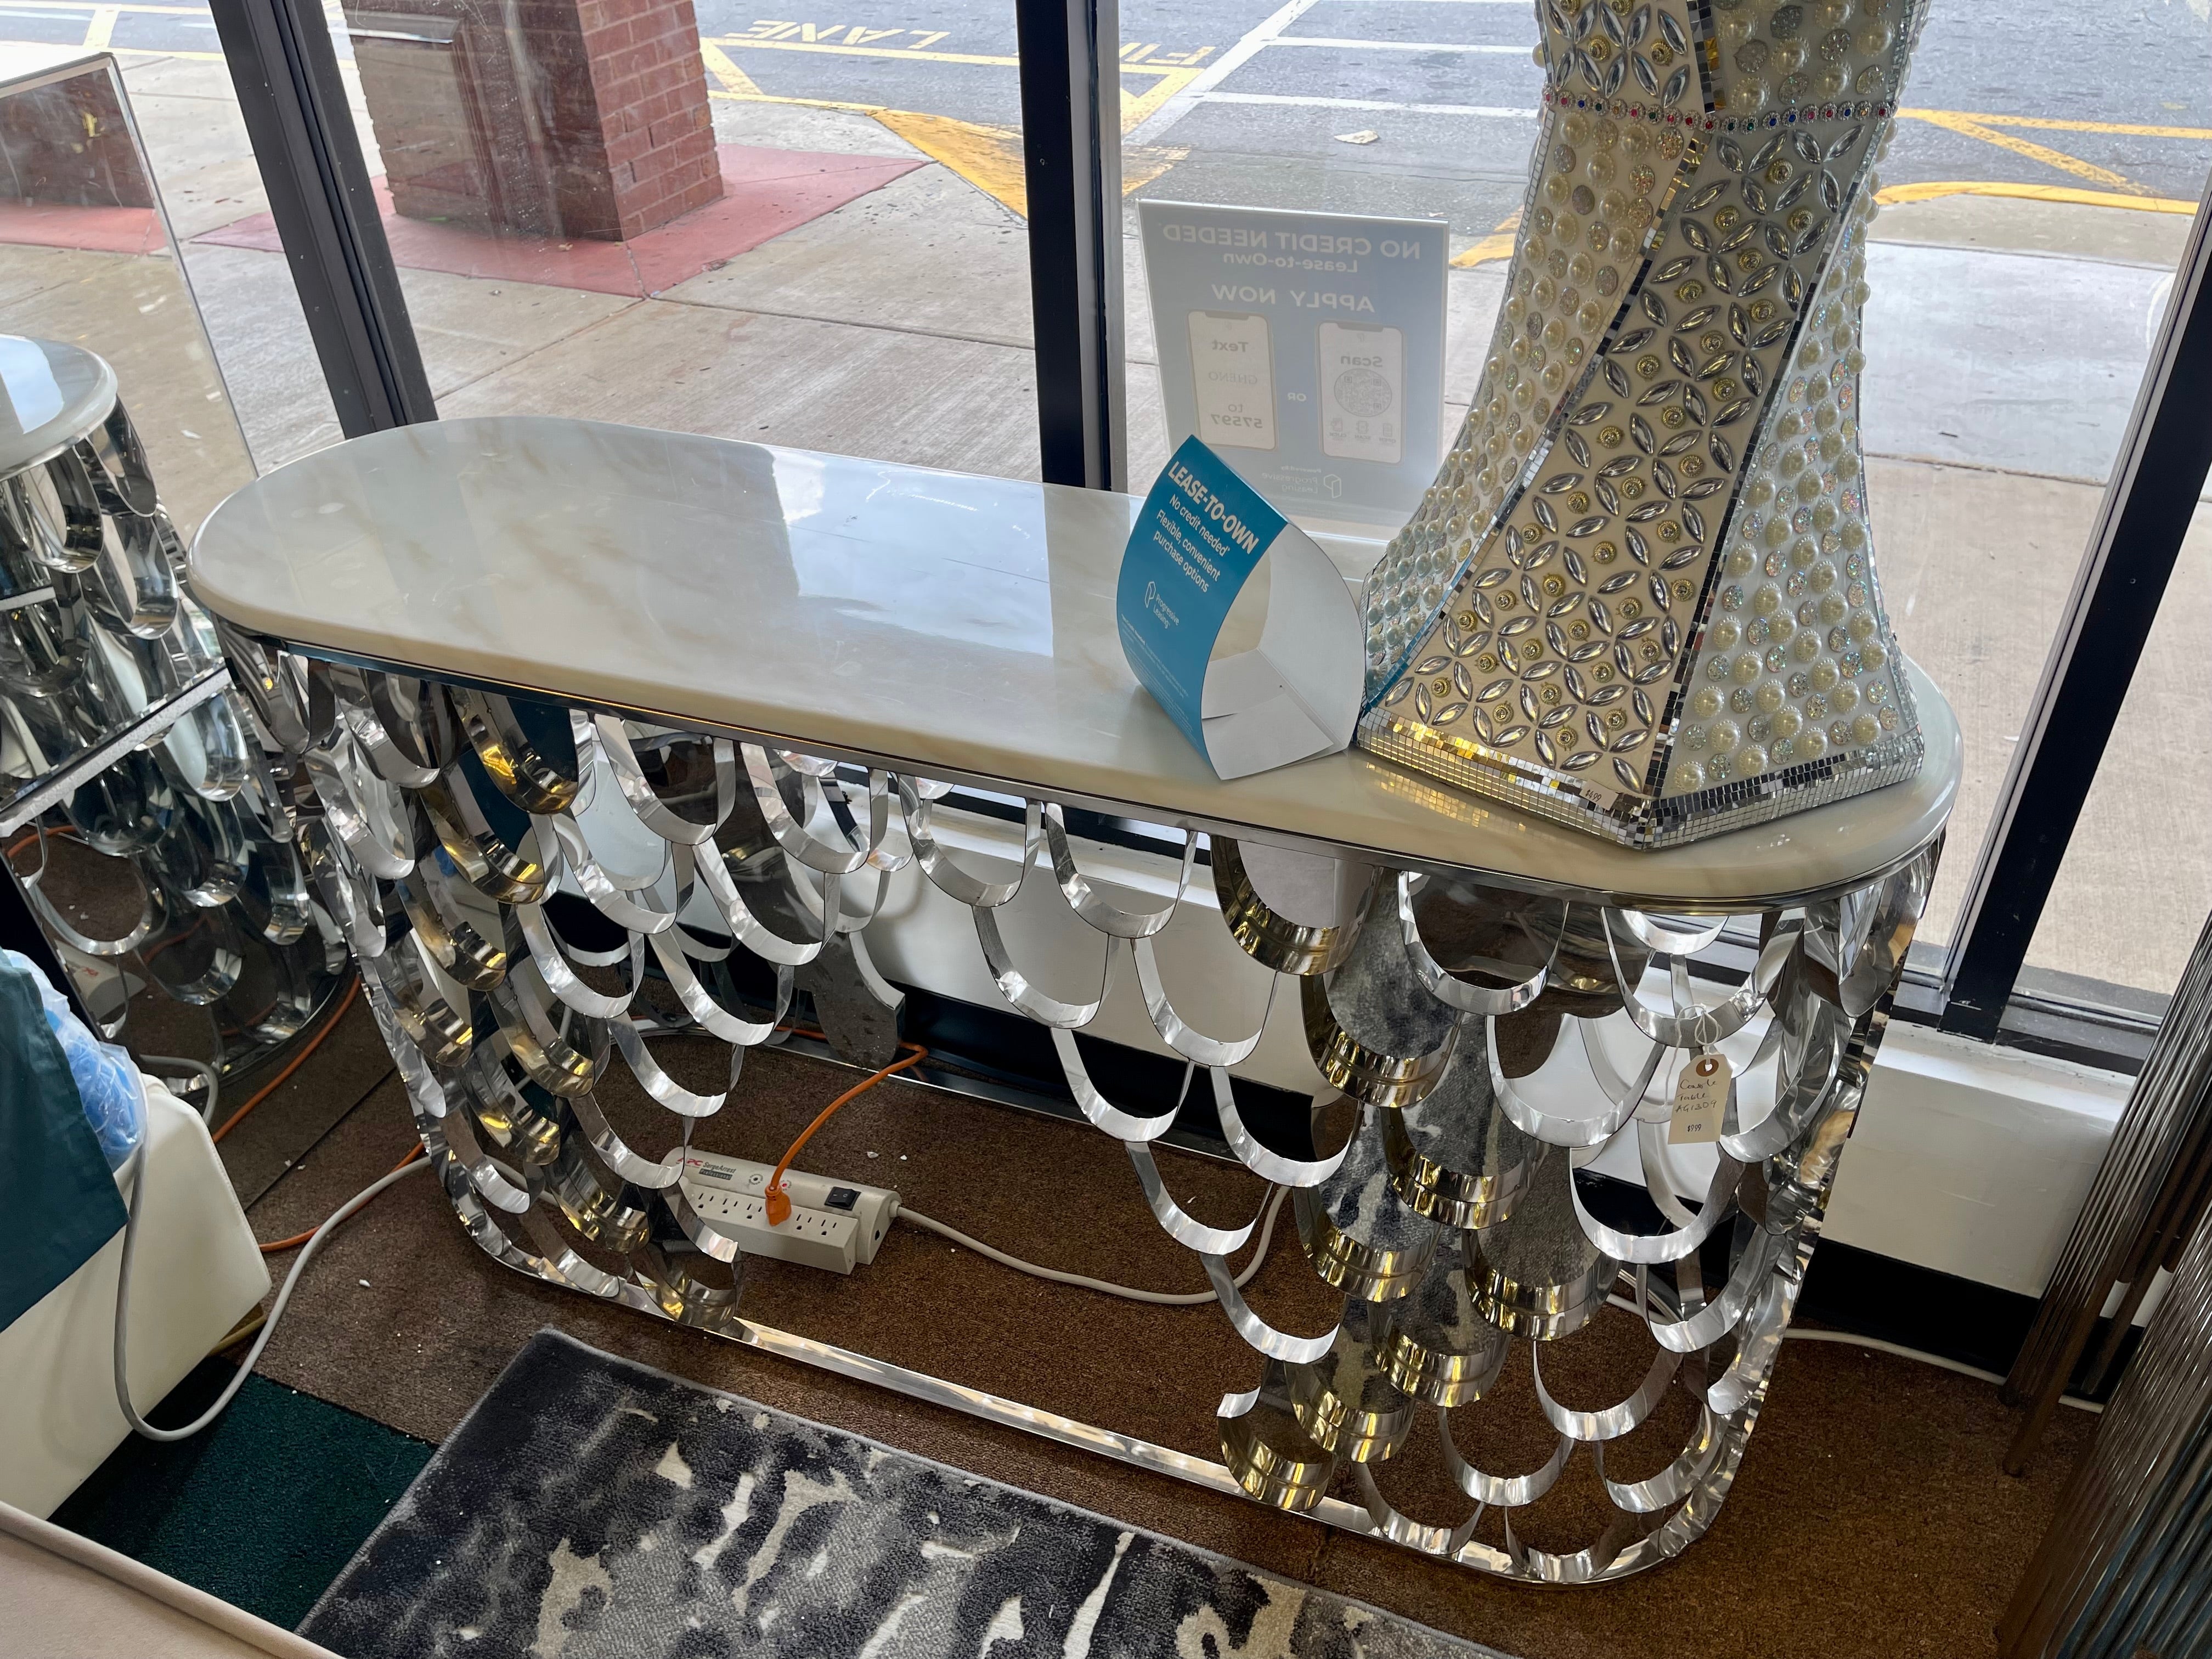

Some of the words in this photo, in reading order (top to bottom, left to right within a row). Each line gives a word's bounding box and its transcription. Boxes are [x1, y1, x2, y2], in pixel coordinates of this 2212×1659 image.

[724, 20, 952, 50] LANE
[1167, 461, 1259, 555] LEASE-TO-OWN
[1169, 494, 1181, 510] No
[1180, 506, 1201, 531] credit
[1156, 509, 1182, 544] Flexible,
[1182, 538, 1221, 582] convenient
[1153, 531, 1183, 566] purchase
[1183, 561, 1209, 592] options
[1156, 594, 1180, 625] Progressive
[1585, 789, 1602, 802] $499
[1677, 1093, 1706, 1102] Table
[1688, 1124, 1702, 1132] $999
[703, 1162, 736, 1173] SurgeArrest
